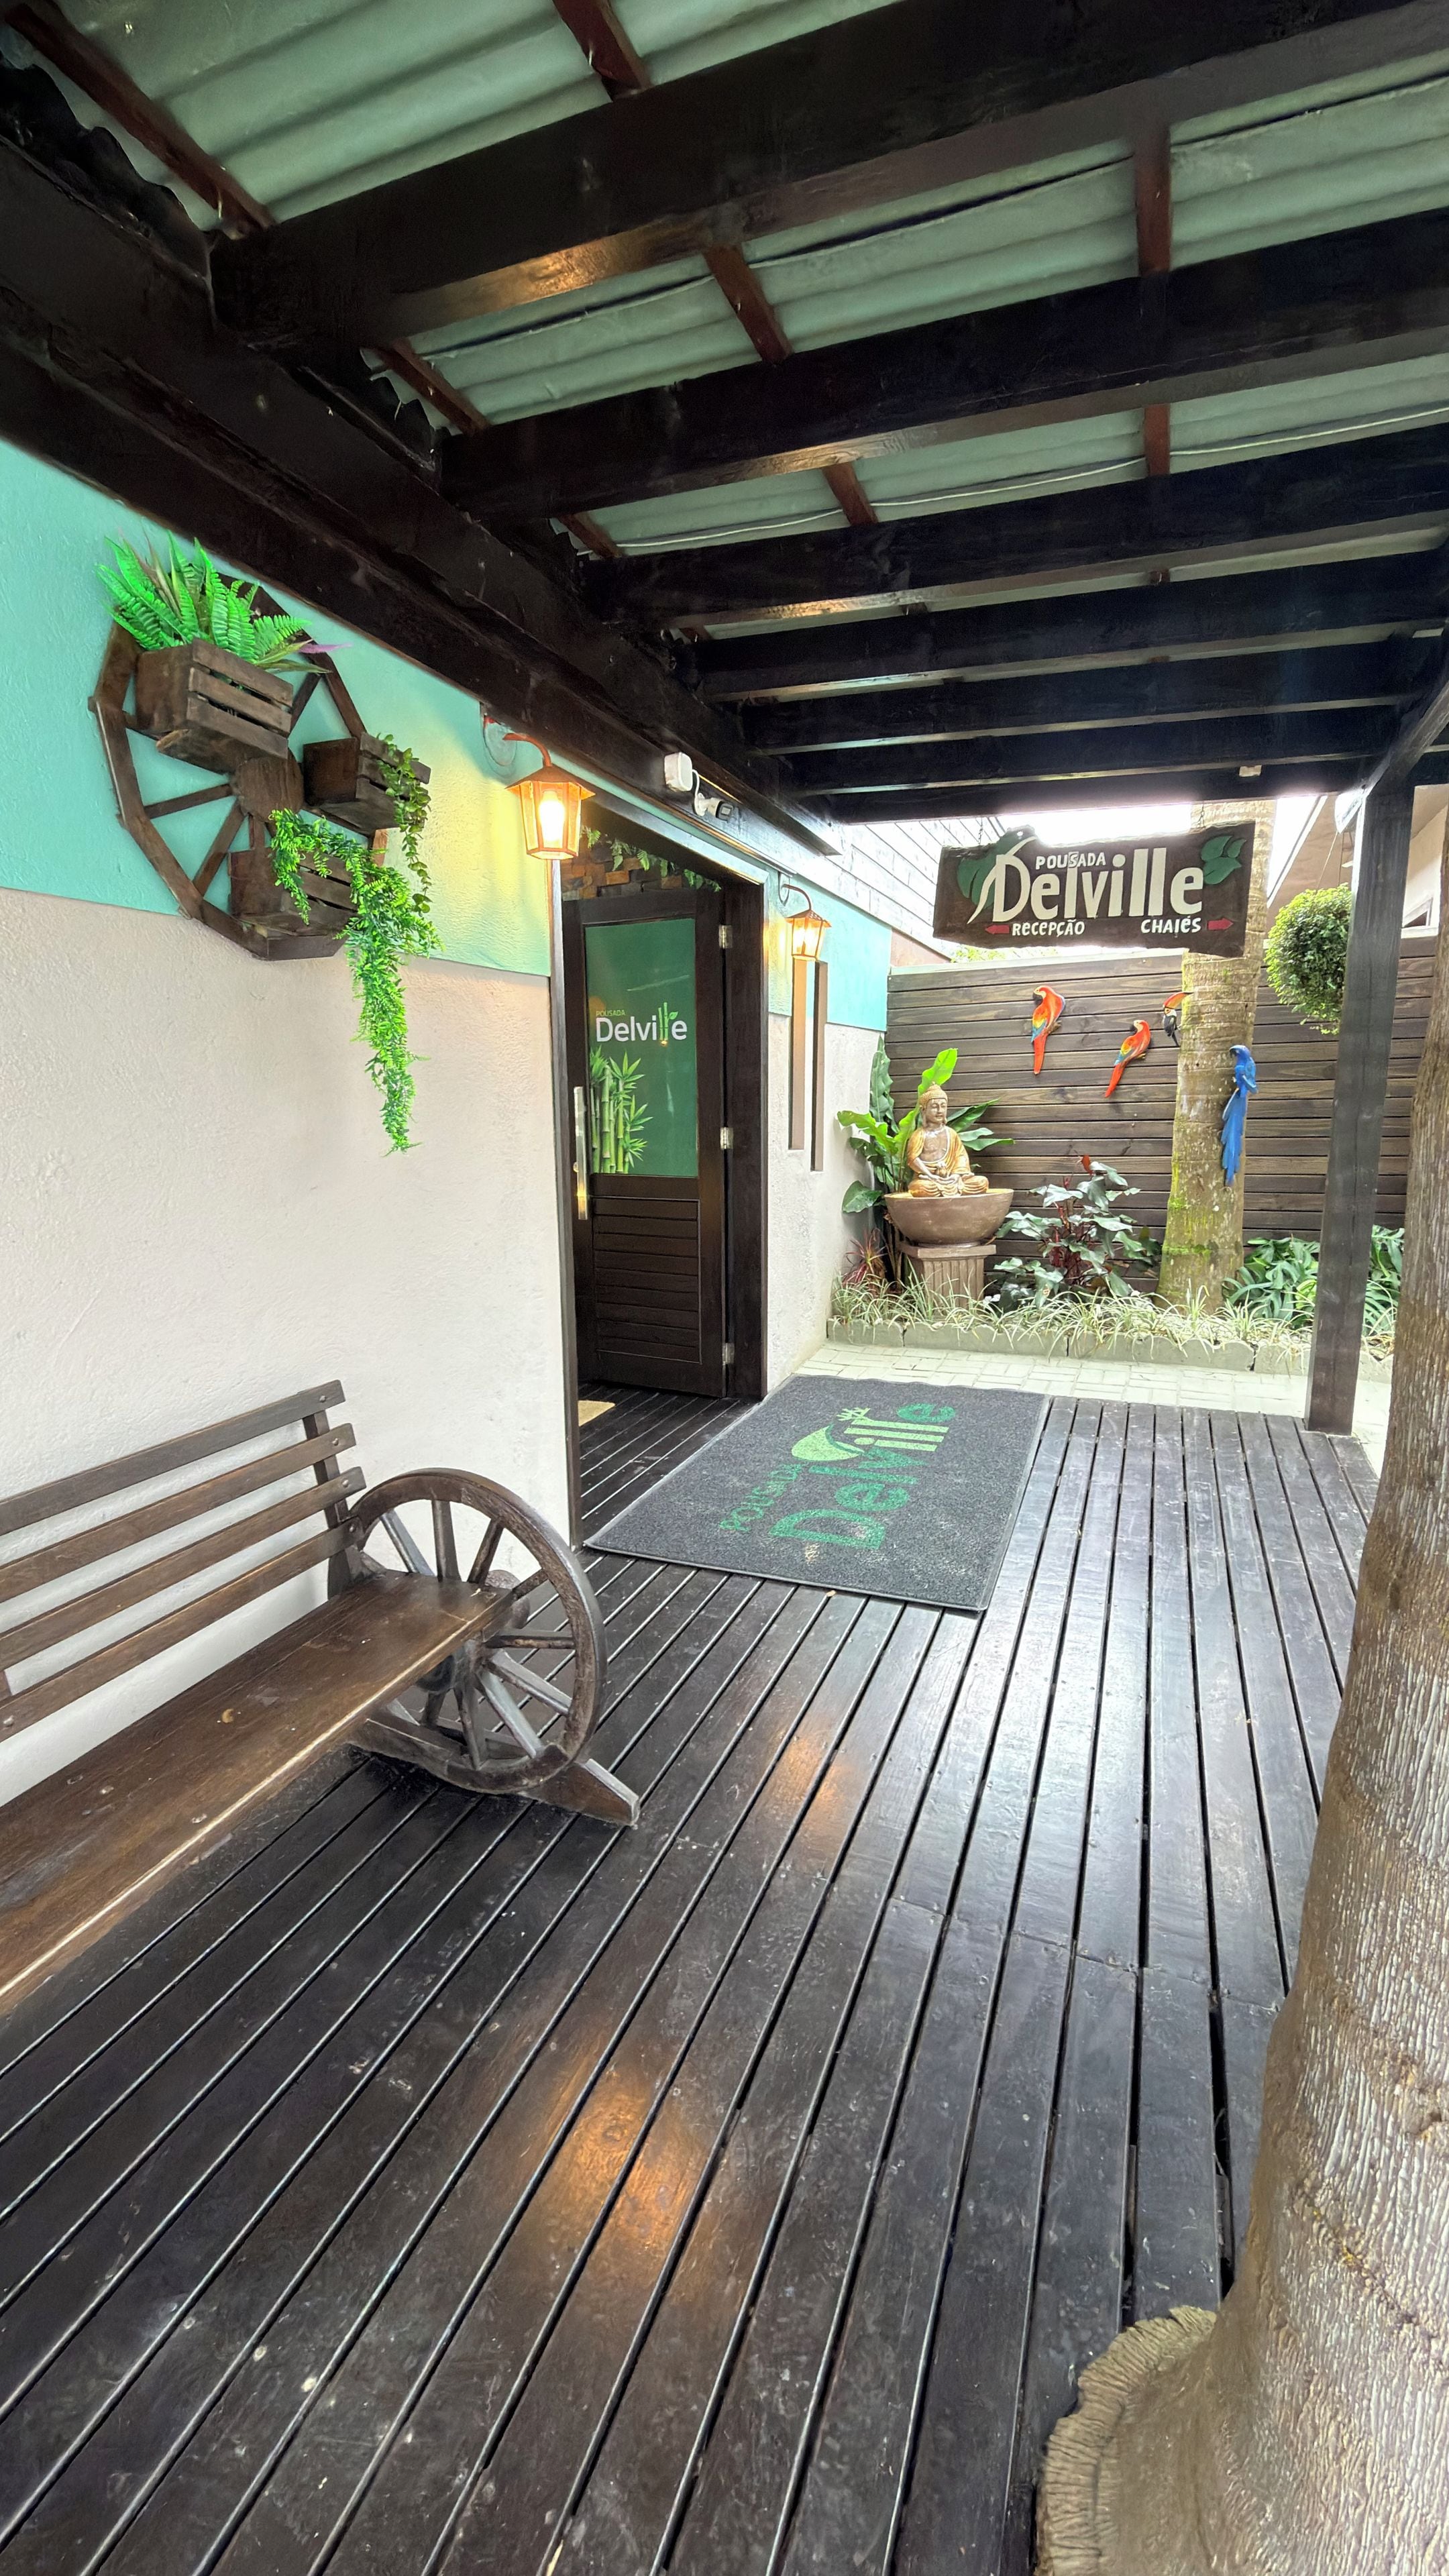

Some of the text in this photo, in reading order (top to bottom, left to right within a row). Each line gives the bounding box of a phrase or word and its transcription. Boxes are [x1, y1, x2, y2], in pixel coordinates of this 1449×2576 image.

[1036, 852, 1106, 870] POUSADA
[990, 847, 1203, 922] Delville
[1012, 919, 1085, 937] RECEPÇÃO
[596, 1002, 688, 1042] Delville
[768, 1403, 957, 1550] Delville
